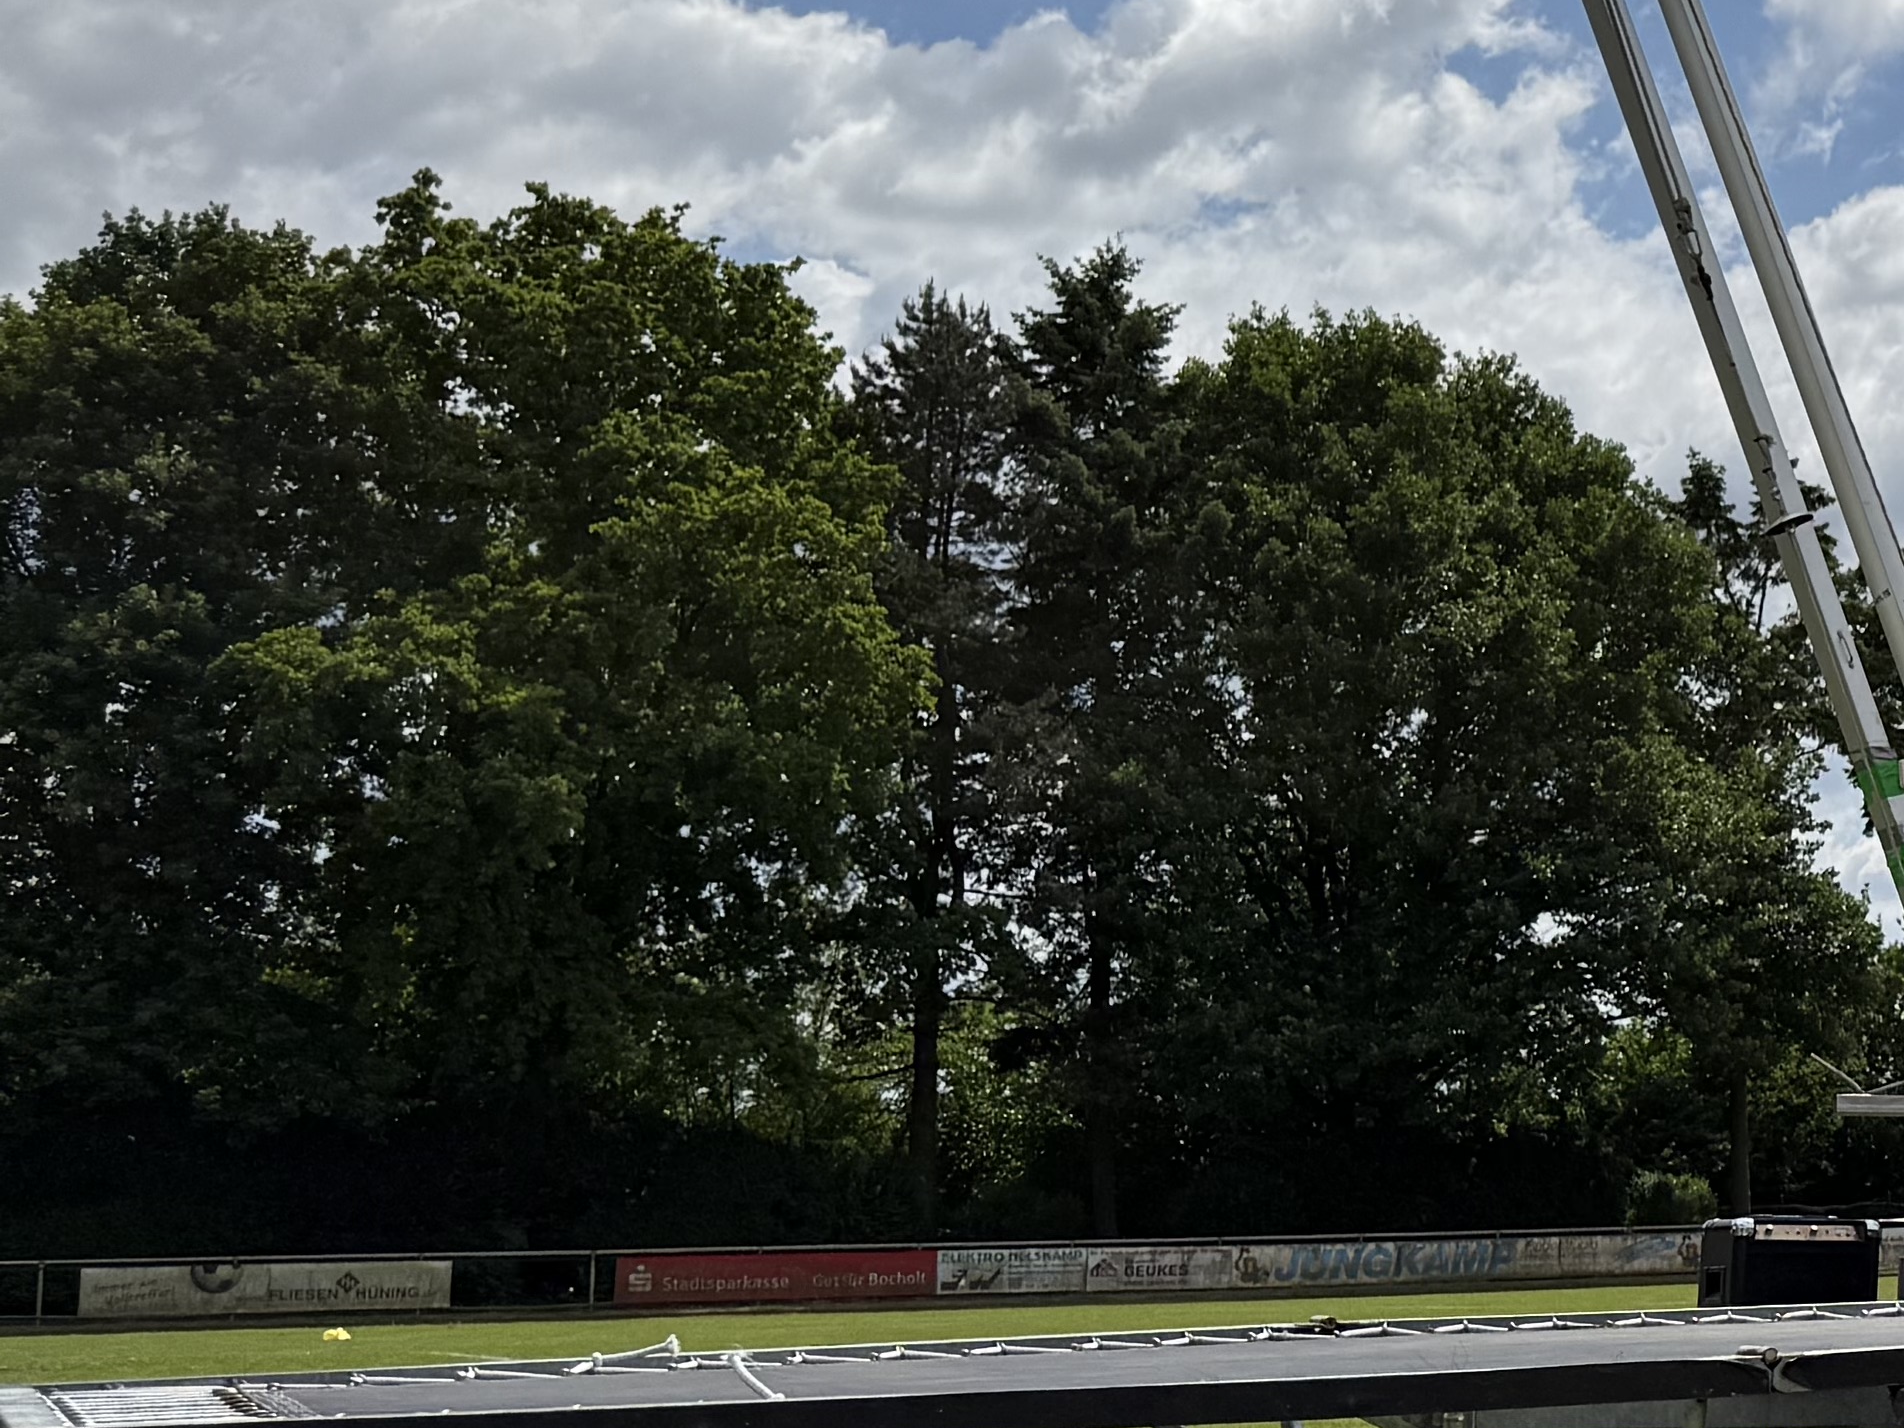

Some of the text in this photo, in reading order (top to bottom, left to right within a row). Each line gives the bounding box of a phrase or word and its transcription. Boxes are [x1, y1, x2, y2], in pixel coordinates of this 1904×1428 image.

[941, 1252, 1005, 1264] ELEKTRO
[1273, 1239, 1517, 1281] JUNGKAMP
[868, 1270, 926, 1286] Bocholt
[1124, 1264, 1189, 1278] GEUKES
[661, 1276, 790, 1292] Stadtsparkasse
[270, 1285, 419, 1302] FLIESEN HÜNING
